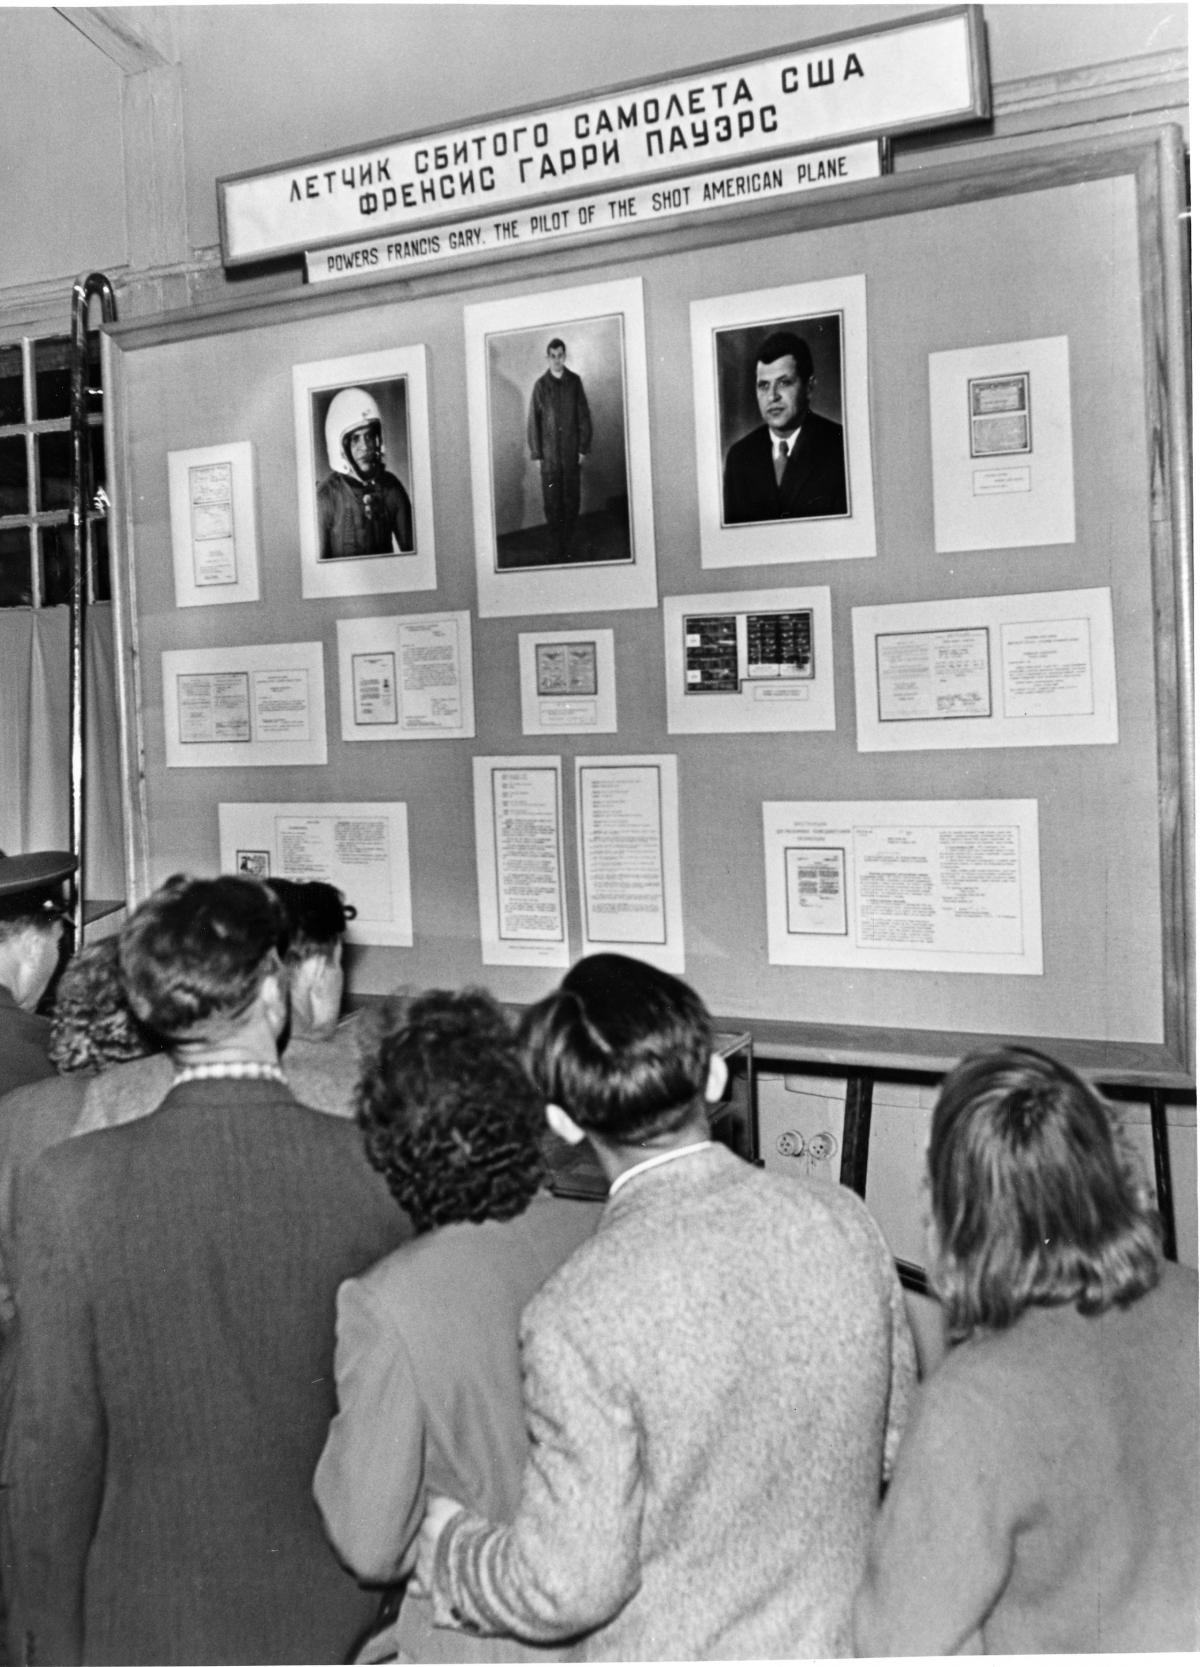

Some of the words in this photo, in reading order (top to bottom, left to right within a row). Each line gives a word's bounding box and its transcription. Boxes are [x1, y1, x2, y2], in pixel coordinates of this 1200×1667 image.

[290, 158, 392, 202] ЛЕТЧИК
[414, 123, 549, 175] СБИТОГО
[574, 78, 753, 139] САМОЛЕТА
[781, 52, 864, 94] США
[359, 166, 496, 215] ФРЕНСИС
[519, 138, 621, 183] ГАРРИ
[646, 105, 778, 157] ПАУЭРС
[327, 247, 379, 272] POWERS
[387, 236, 441, 262] FRANCIS
[494, 220, 519, 241] THE
[530, 210, 569, 234] PILOT
[579, 205, 596, 225] OF
[608, 197, 637, 219] THE
[652, 187, 691, 212] SHOT
[703, 169, 783, 202] AMERICAN
[797, 156, 849, 184] PLANE
